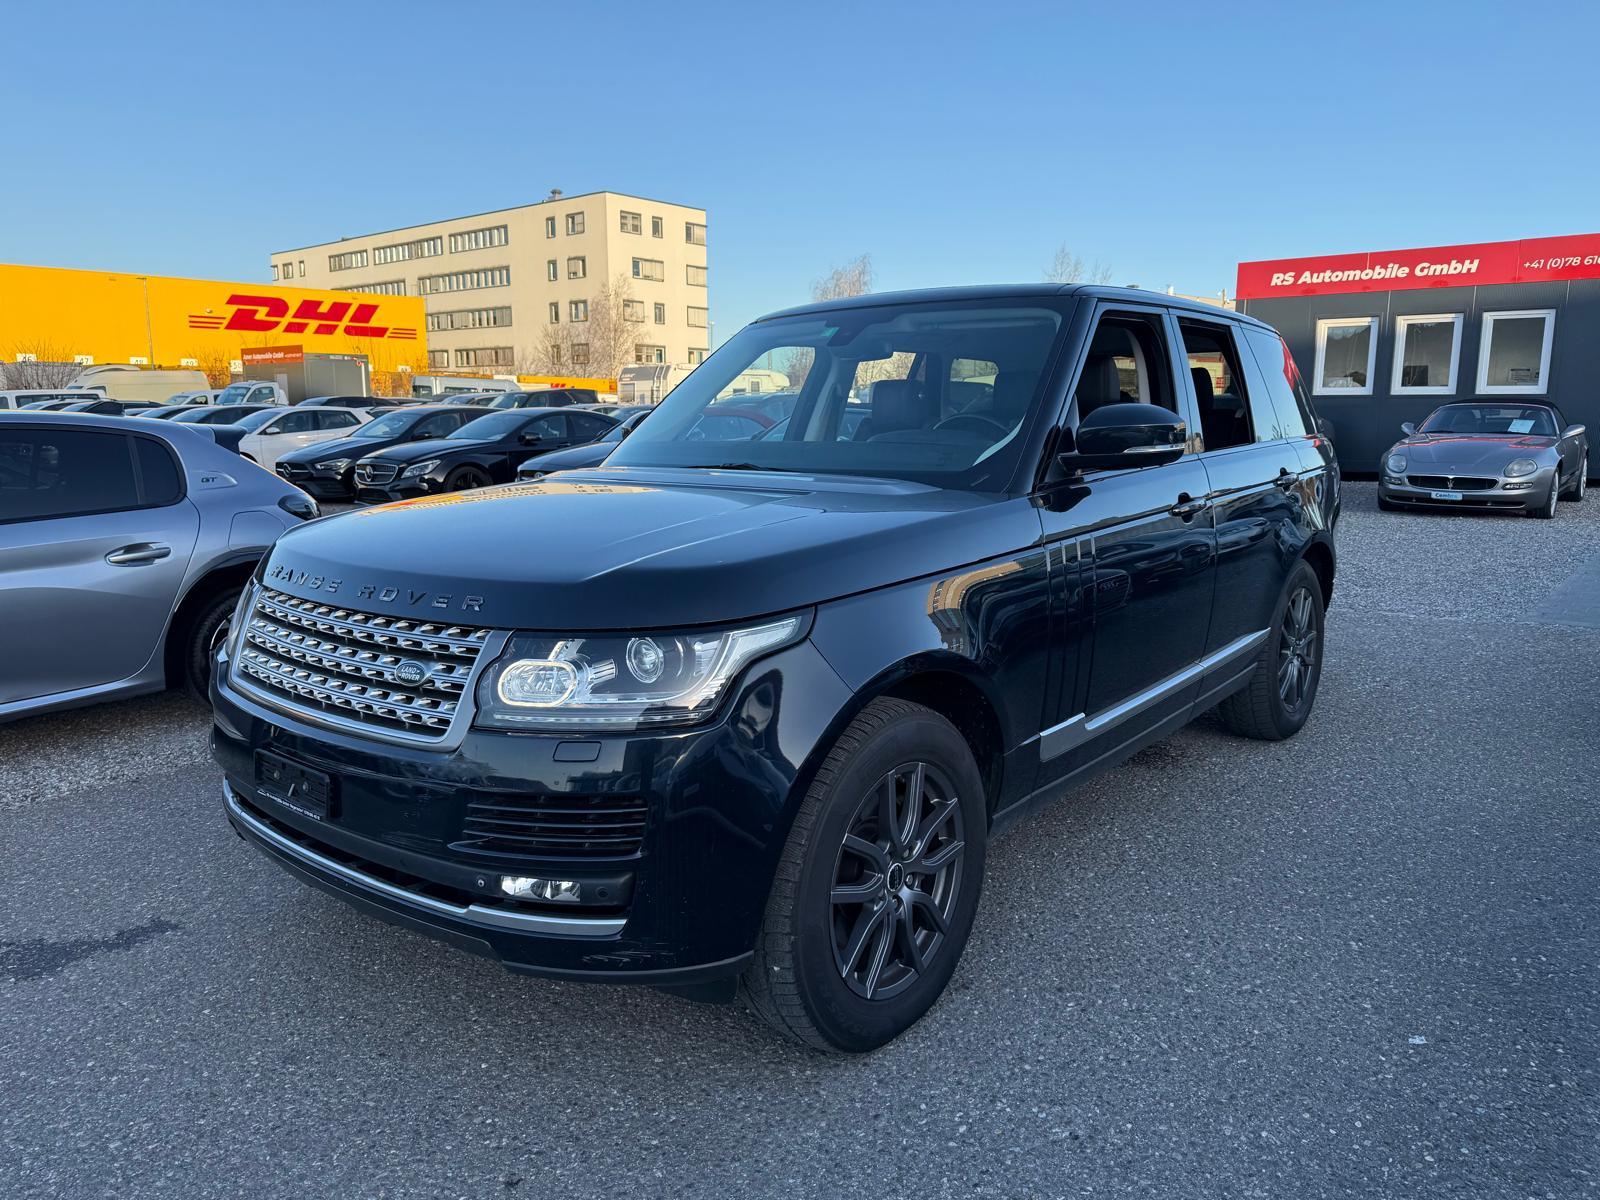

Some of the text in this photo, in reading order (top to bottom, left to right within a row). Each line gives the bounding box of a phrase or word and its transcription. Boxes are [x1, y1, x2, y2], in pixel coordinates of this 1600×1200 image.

[1271, 259, 1479, 286] RS Automobile GmbH
[1523, 259, 1544, 269] +41
[1547, 256, 1581, 270] (0)78
[224, 294, 389, 338] DHL
[268, 563, 484, 612] RANGE ROVER
[400, 673, 420, 681] ROVER
